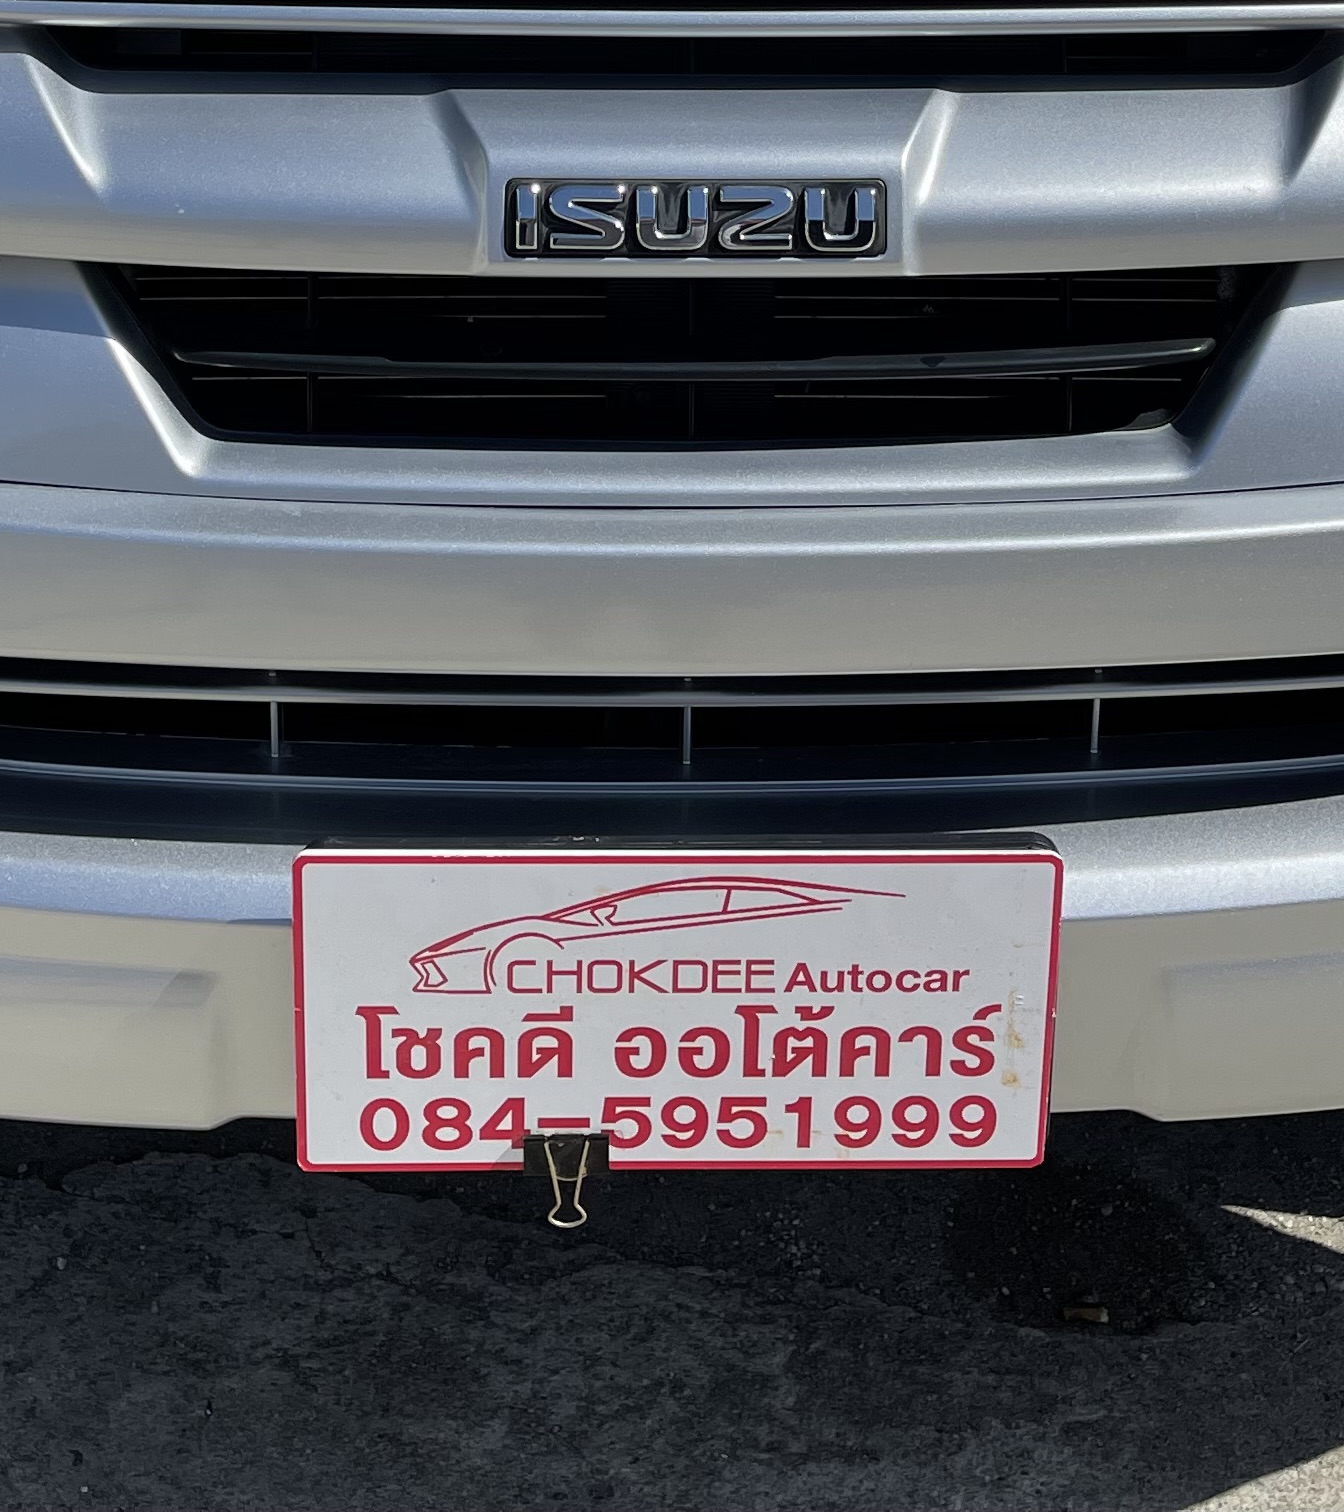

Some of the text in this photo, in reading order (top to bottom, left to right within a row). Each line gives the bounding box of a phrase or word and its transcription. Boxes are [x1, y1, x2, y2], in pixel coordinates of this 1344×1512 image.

[515, 187, 876, 250] ISUZU
[507, 959, 969, 994] CHOKDEE Autocar
[356, 1003, 1002, 1080] โชคดี ออโต้คาร์
[359, 1094, 997, 1152] 084-5951999
